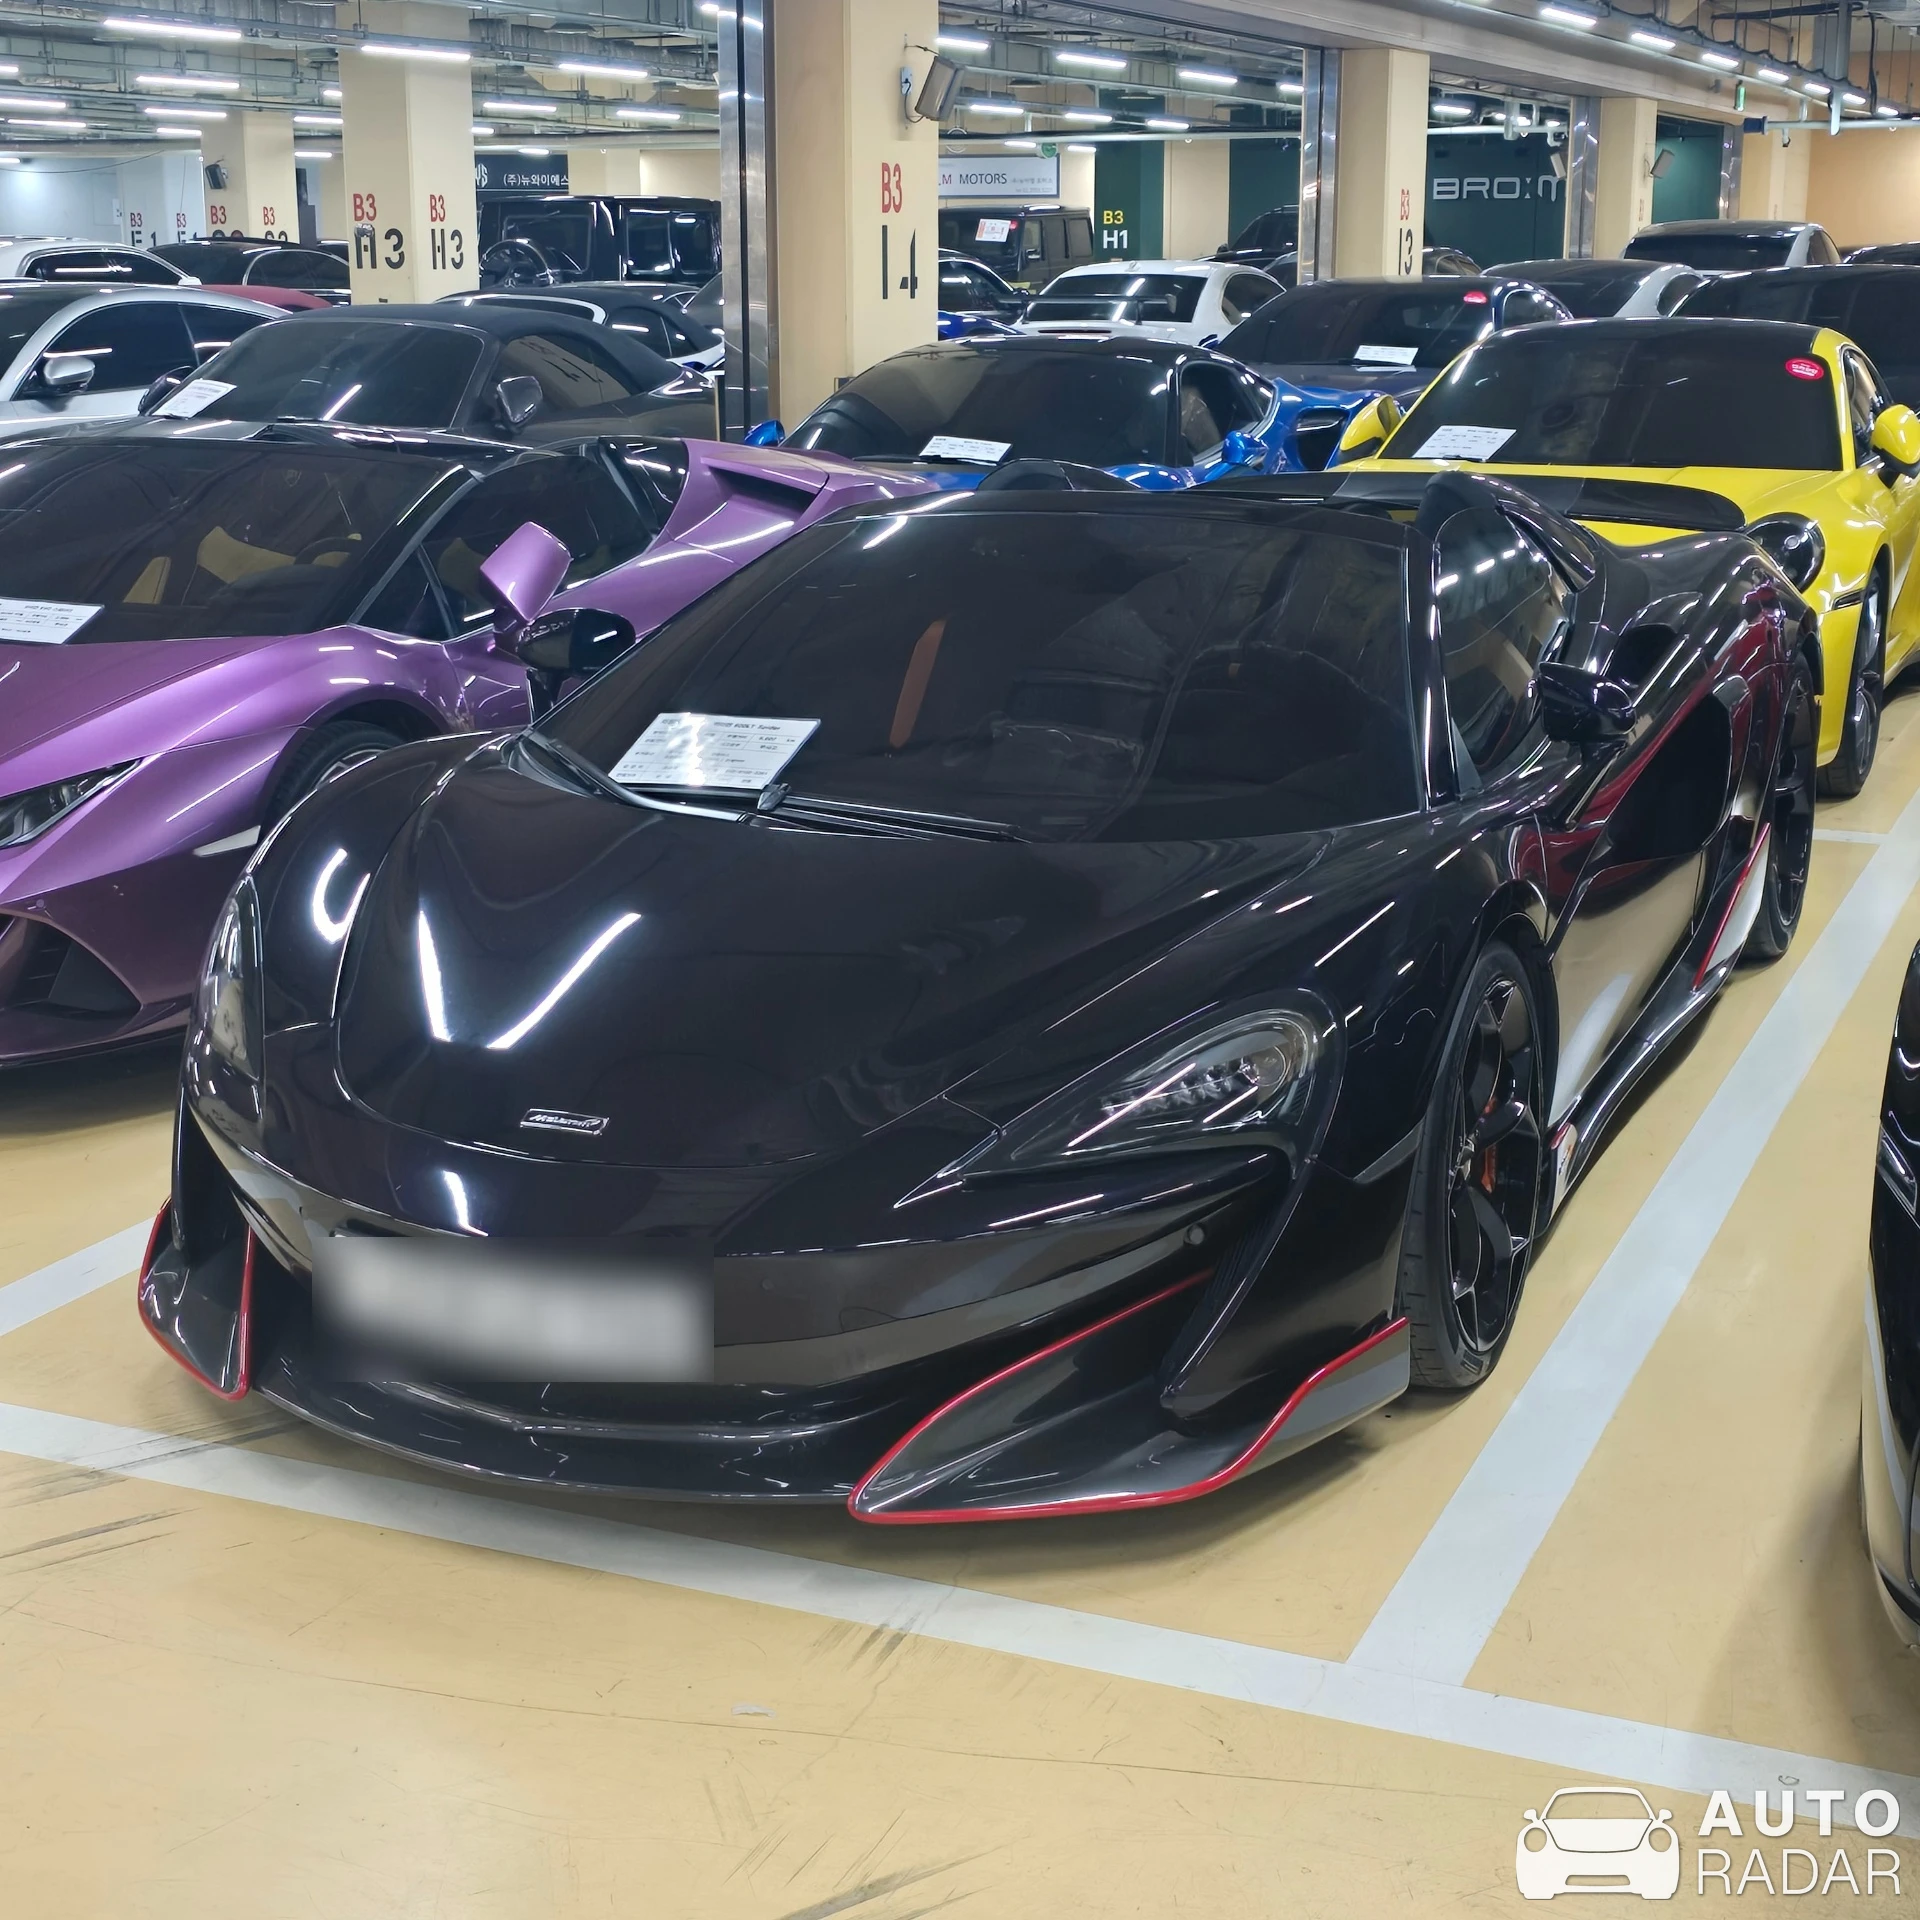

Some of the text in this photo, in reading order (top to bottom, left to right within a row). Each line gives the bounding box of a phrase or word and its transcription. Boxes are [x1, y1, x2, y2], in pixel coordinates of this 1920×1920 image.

[881, 162, 902, 213] B3
[959, 172, 1008, 185] MOTORS
[210, 205, 227, 225] B3
[263, 206, 276, 226] B3
[353, 193, 377, 221] B3
[429, 194, 445, 222] B3
[130, 212, 143, 228] B3
[176, 212, 187, 228] B3
[1103, 210, 1124, 225] B3
[1103, 229, 1128, 249] H1
